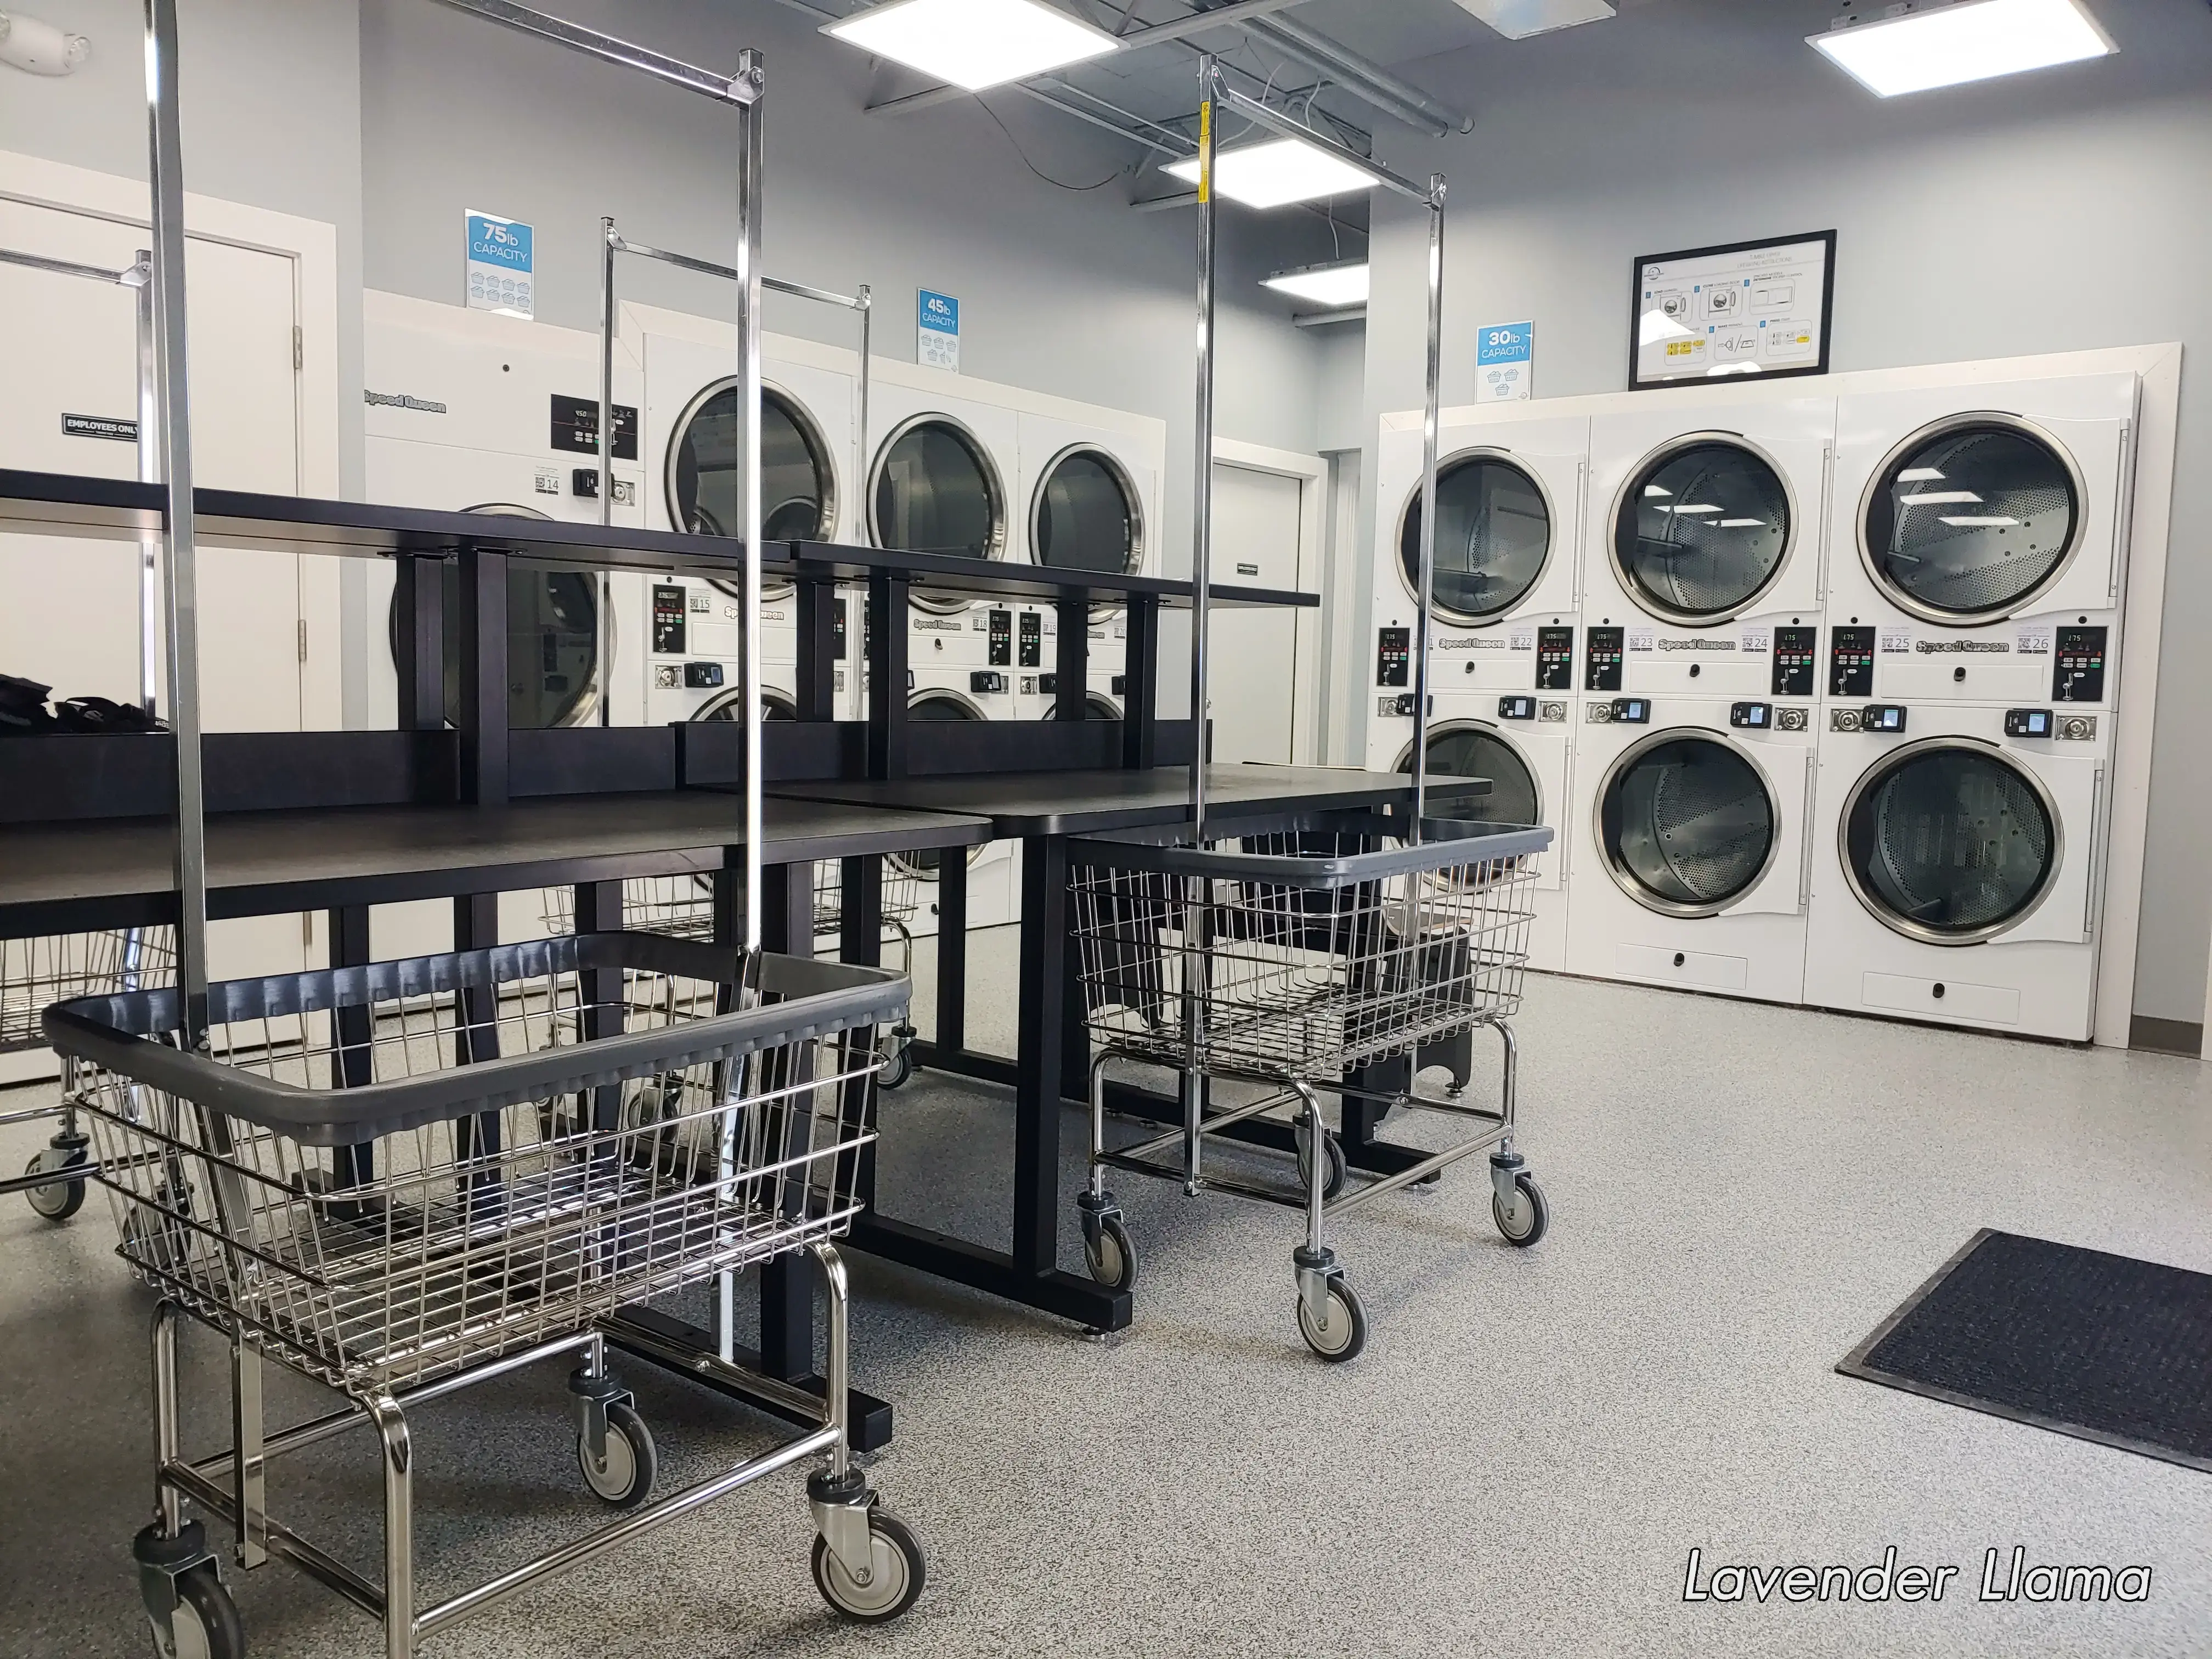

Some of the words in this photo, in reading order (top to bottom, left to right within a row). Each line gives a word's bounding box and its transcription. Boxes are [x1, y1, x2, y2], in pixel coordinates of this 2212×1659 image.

[483, 222, 518, 246] 75lb
[473, 241, 528, 263] CAPACITY
[928, 298, 950, 315] 45lb
[922, 313, 956, 328] CAPACITY
[1488, 330, 1520, 346] 30lb
[1481, 345, 1527, 358] CAPACITY
[364, 389, 404, 406] Speed
[404, 395, 447, 414] Queen
[67, 419, 117, 432] EMPLOYEES
[547, 479, 559, 490] 14
[700, 599, 710, 608] 15
[760, 610, 785, 620] ueen
[913, 619, 938, 630] Speed
[980, 619, 987, 628] 18
[1438, 638, 1471, 650] Speed
[1471, 637, 1505, 648] Queen
[1520, 637, 1532, 646] 22
[1641, 637, 1653, 647] 23
[1658, 639, 1697, 651] Speed
[1697, 639, 1736, 650] Queen
[1754, 638, 1768, 647] 24
[1895, 638, 1909, 648] 25
[1916, 640, 1962, 654] Speed
[1962, 640, 2009, 652] Queen
[2033, 638, 2049, 648] 26
